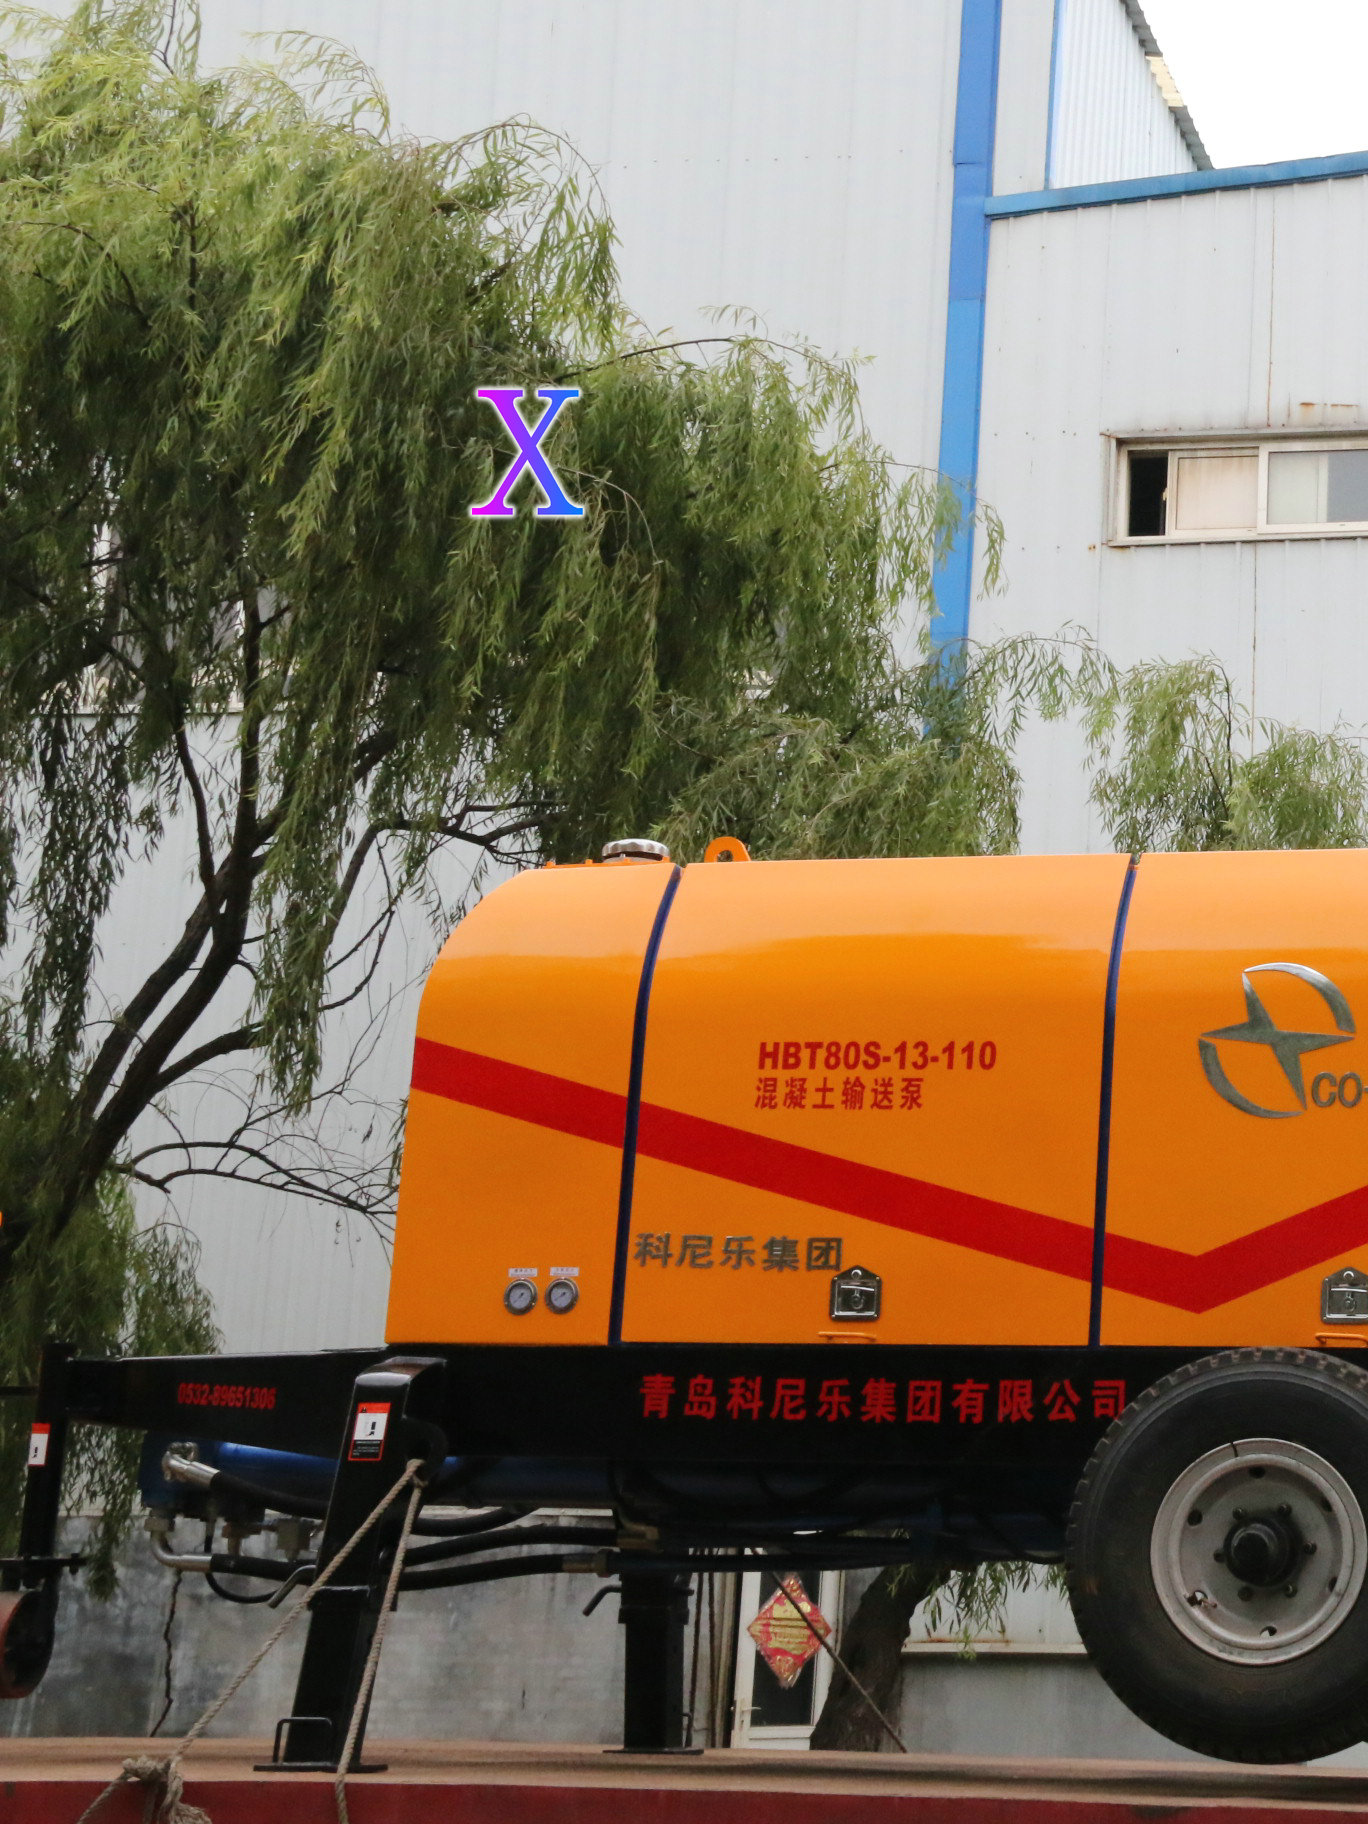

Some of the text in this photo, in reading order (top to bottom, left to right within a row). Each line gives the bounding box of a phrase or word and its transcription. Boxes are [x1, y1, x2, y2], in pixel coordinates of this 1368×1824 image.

[758, 1040, 997, 1071] HBT80S-13-110
[754, 1076, 924, 1111] 混凝土输送泵
[634, 1231, 844, 1272] 科尼乐集团
[639, 1373, 1126, 1424] 青岛科尼乐集团有限公司
